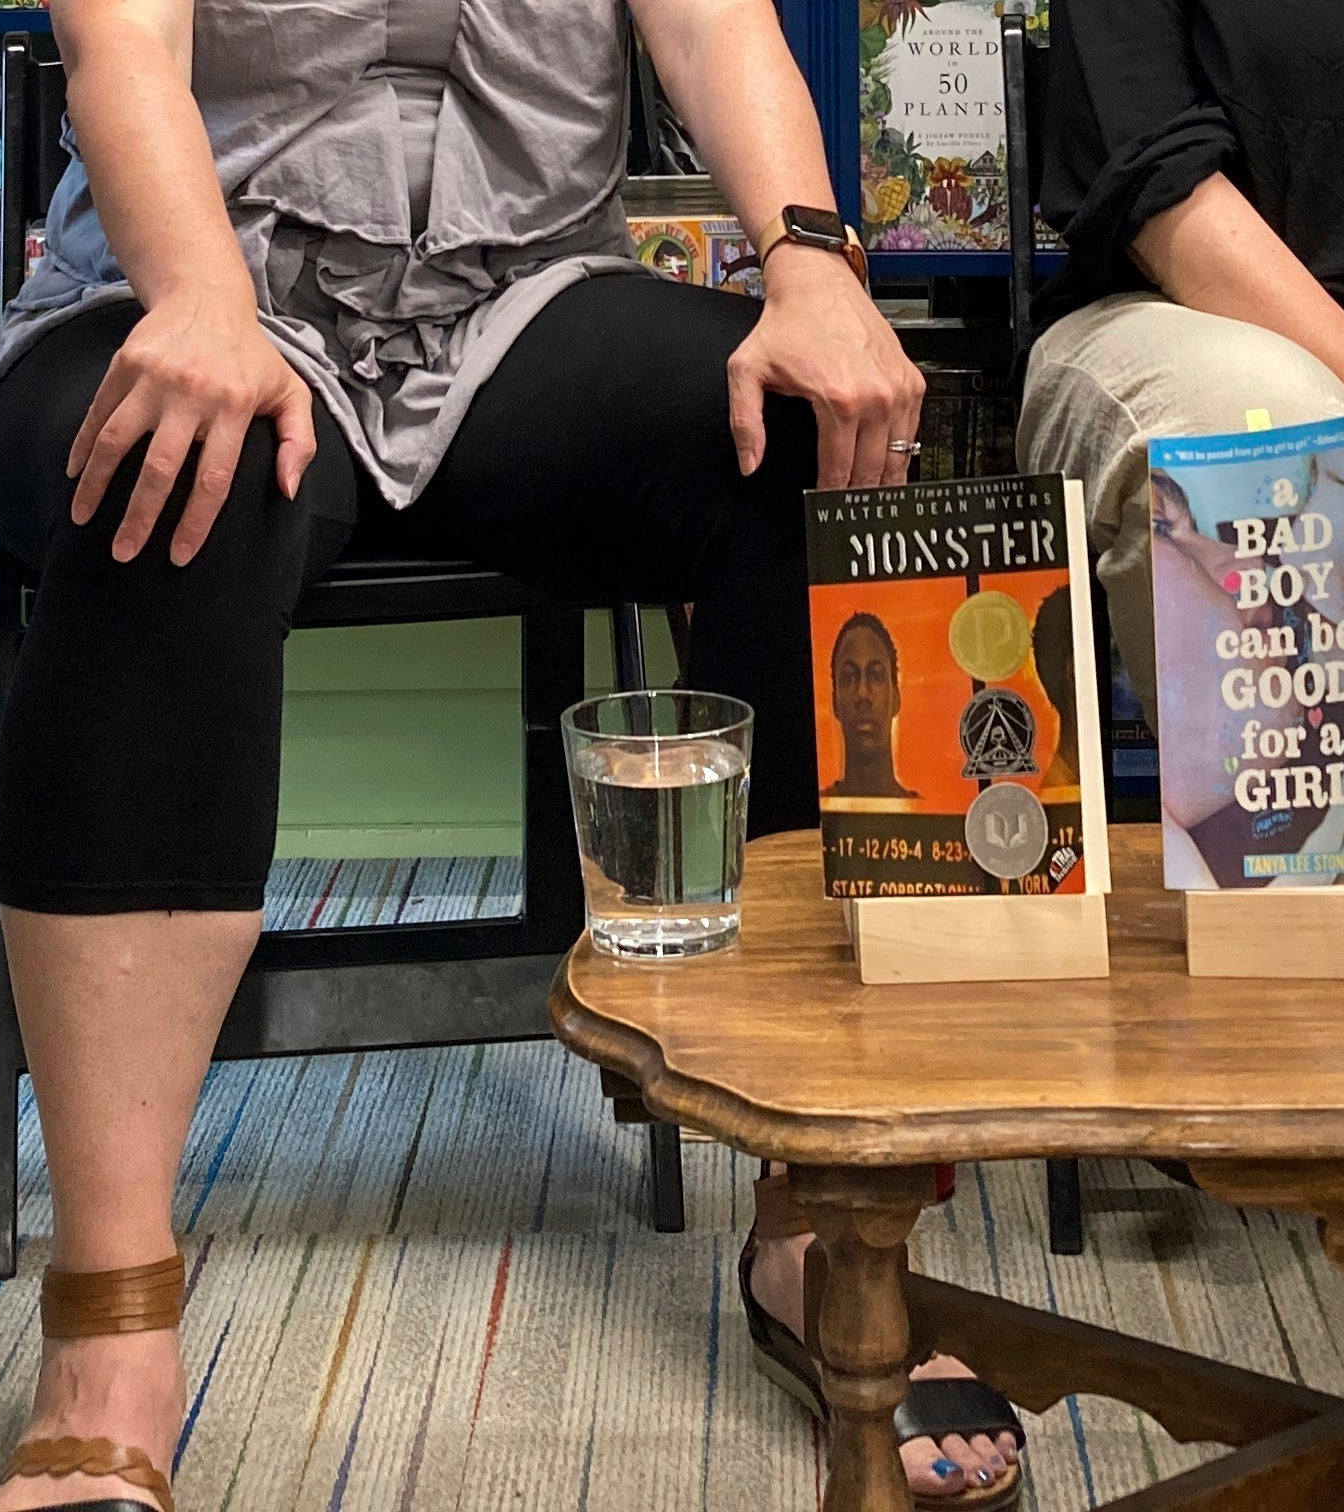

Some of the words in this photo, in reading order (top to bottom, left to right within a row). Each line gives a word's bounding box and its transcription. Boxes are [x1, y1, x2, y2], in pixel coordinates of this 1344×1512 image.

[908, 41, 999, 56] WORLD
[939, 73, 968, 94] 50
[904, 102, 1004, 117] PLANTS
[817, 506, 899, 524] WALTER
[916, 499, 968, 517] DEAN
[985, 492, 1052, 511] MYERS
[845, 493, 864, 504] New
[878, 491, 906, 502] York
[914, 488, 950, 499] Times
[1273, 477, 1298, 508] a
[849, 519, 1056, 577] MONSTER
[1233, 514, 1334, 559] BAD
[1236, 561, 1334, 610] BOY
[1216, 624, 1298, 660] can
[1240, 721, 1305, 761] for
[1319, 723, 1344, 756] a
[1248, 855, 1287, 874] TANYA
[1290, 854, 1311, 873] LEE
[1018, 874, 1051, 894] YORK
